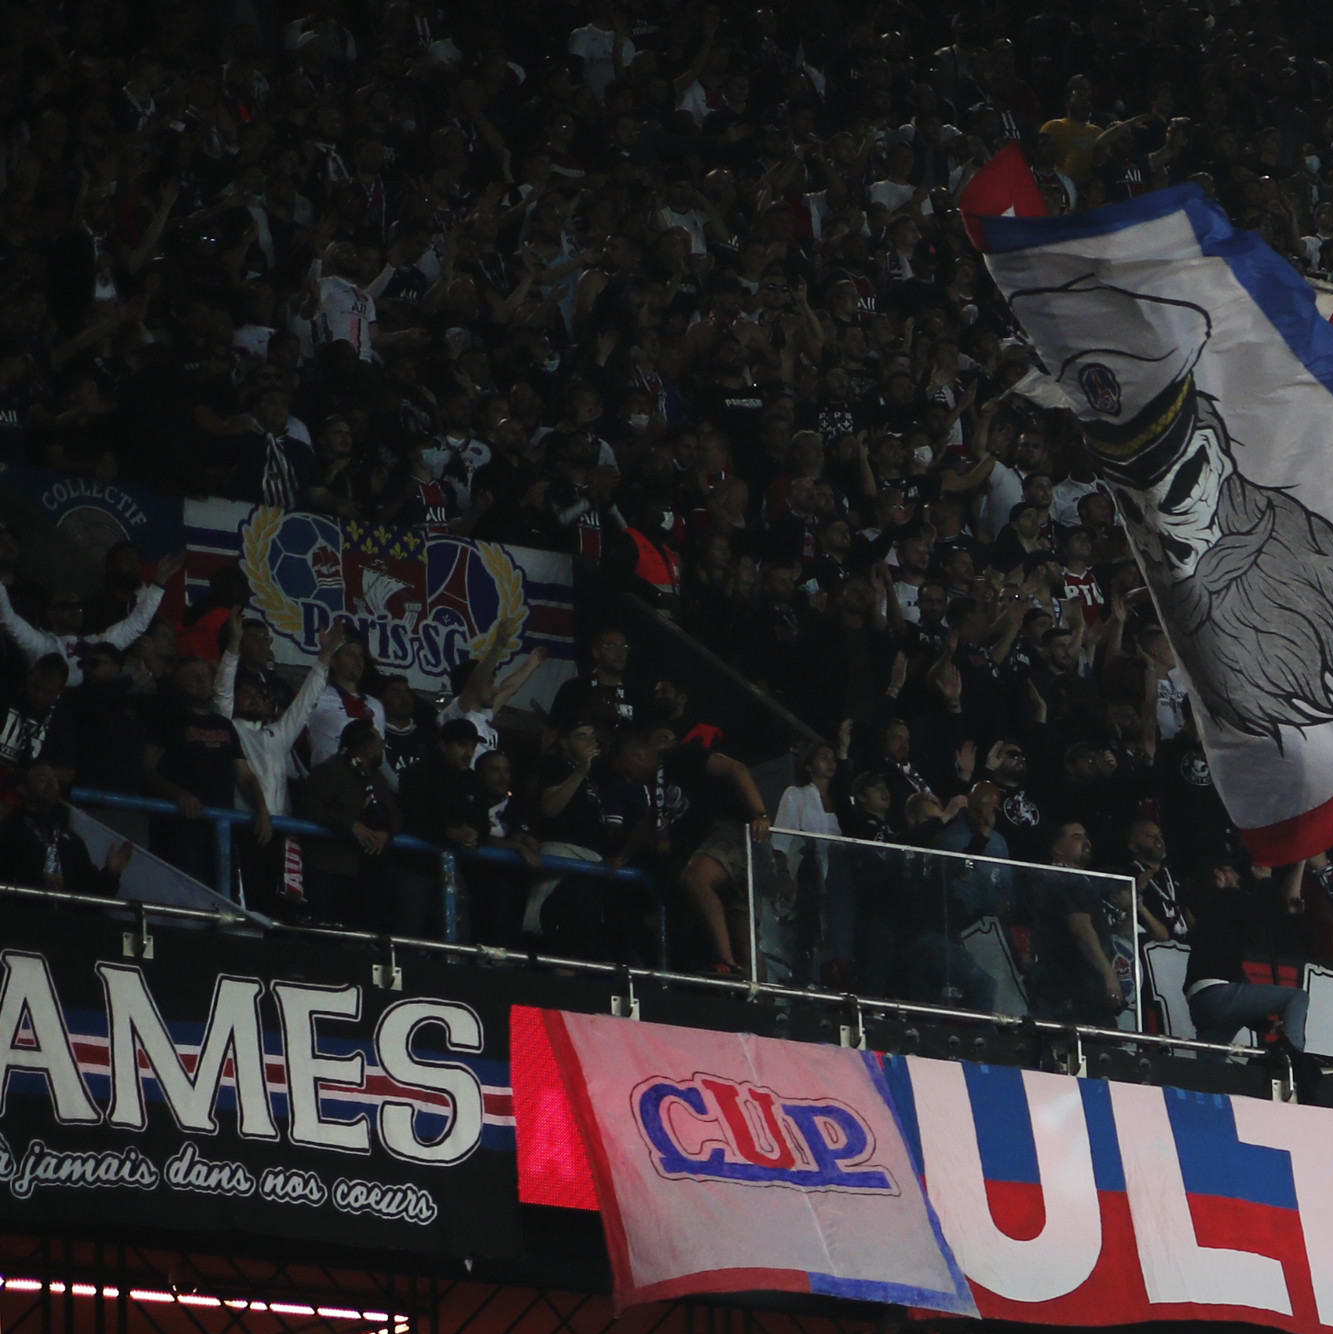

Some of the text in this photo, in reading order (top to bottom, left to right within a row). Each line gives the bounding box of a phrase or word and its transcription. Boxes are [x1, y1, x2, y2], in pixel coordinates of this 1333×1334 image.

[41, 474, 149, 531] COLLECTIF
[634, 1073, 894, 1192] CUP
[12, 1141, 159, 1197] jamais
[167, 1143, 254, 1194] dans
[261, 1166, 327, 1205] nos
